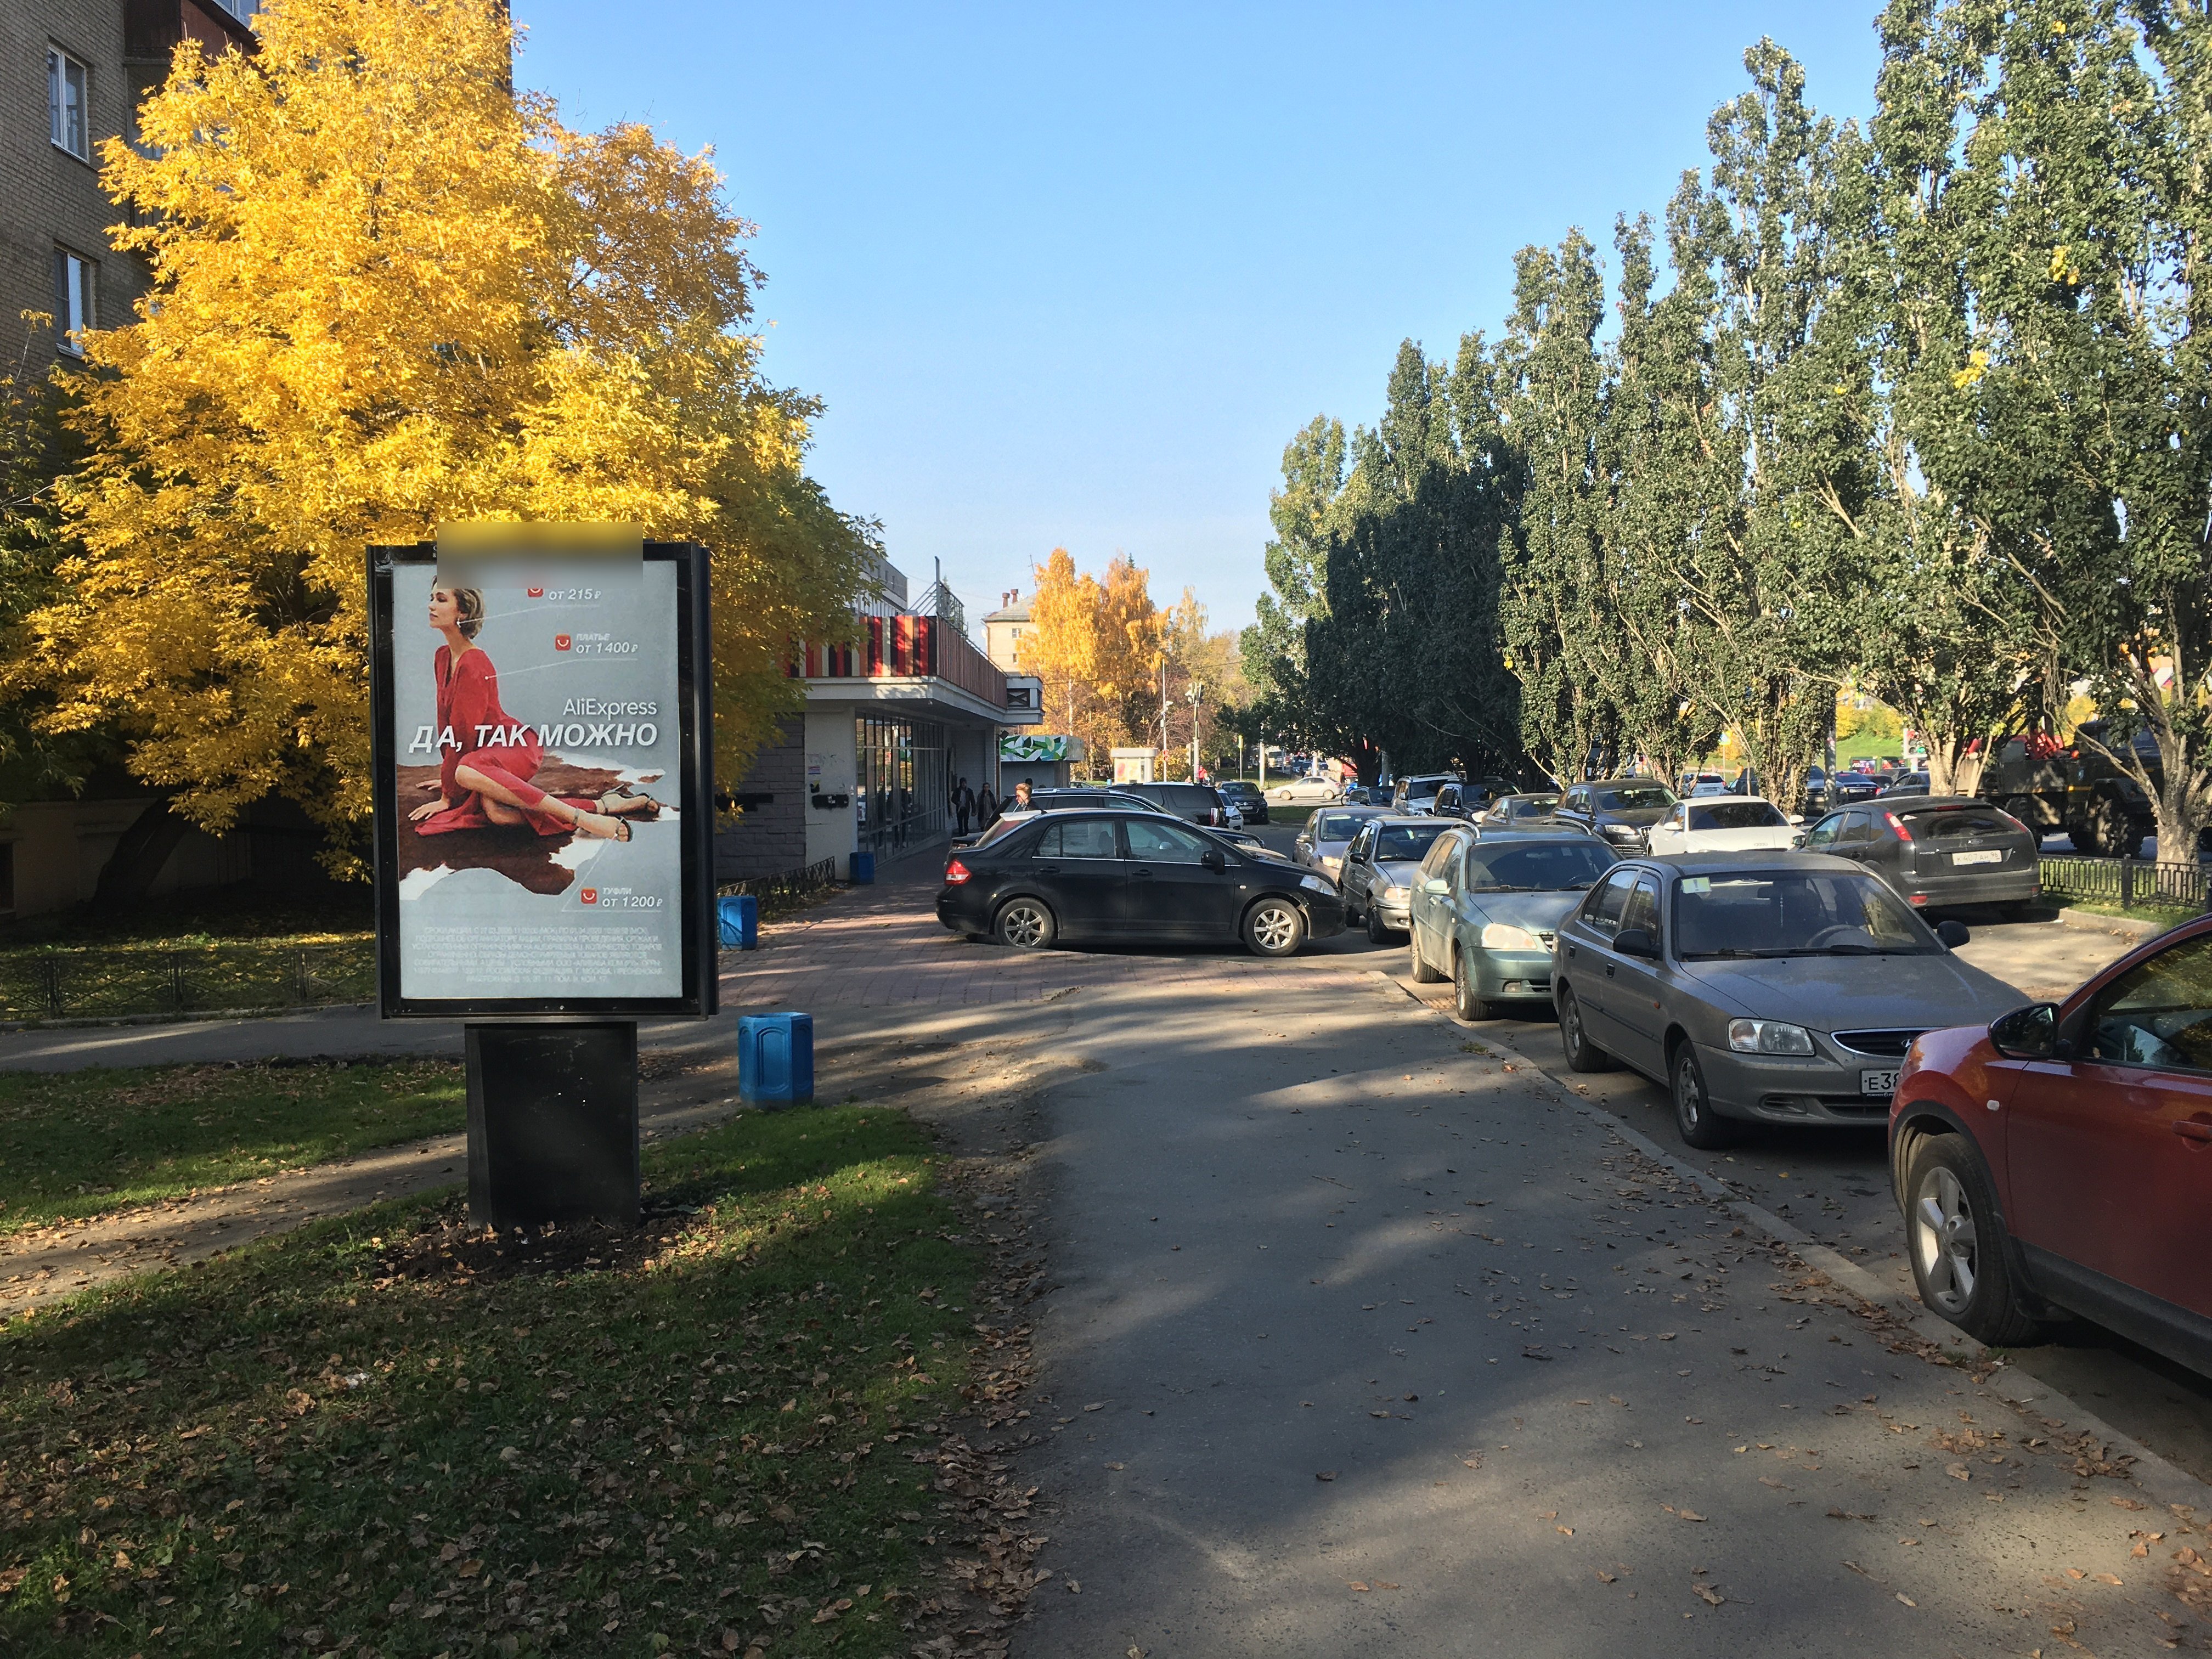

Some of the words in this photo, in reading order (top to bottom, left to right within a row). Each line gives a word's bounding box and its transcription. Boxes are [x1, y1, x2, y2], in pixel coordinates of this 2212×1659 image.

[562, 698, 658, 720] AliExpress
[409, 725, 462, 753] ДА,
[474, 724, 532, 747] ТАК
[537, 723, 658, 747] МОЖНО
